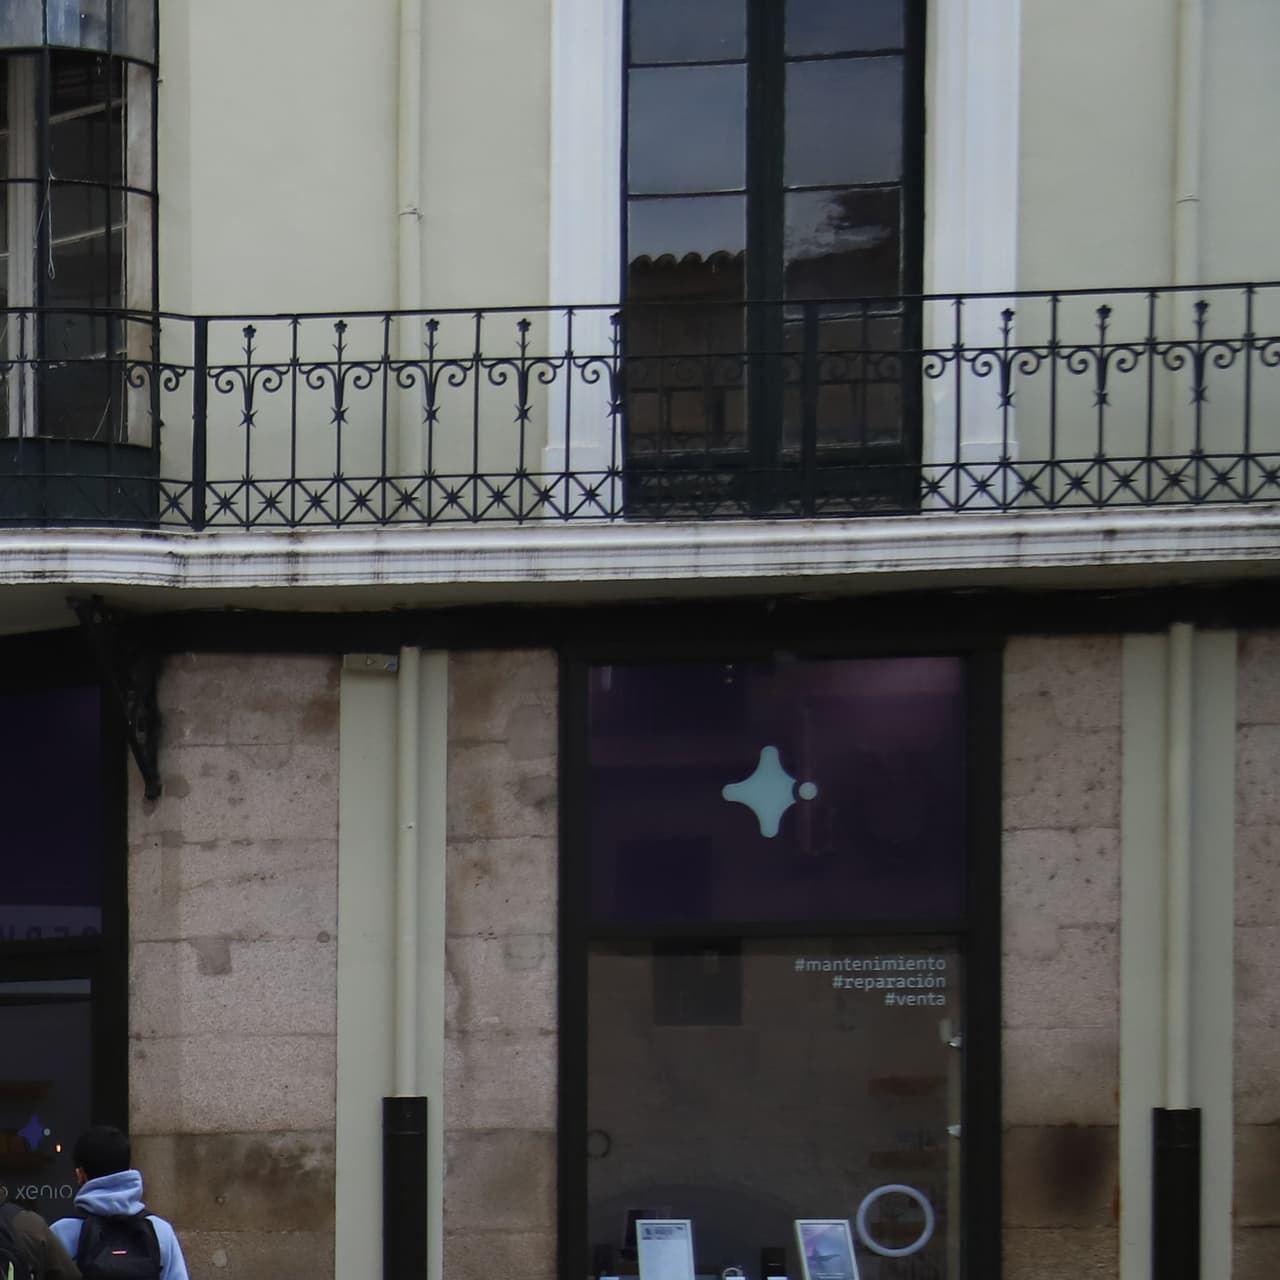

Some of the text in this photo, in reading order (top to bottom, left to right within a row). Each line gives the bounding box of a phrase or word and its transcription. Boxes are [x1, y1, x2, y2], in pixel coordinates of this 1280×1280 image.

[794, 955, 947, 973] #mantenimiento
[832, 972, 947, 992] #reparación
[883, 991, 947, 1007] #venta
[15, 1184, 73, 1200] xenio
